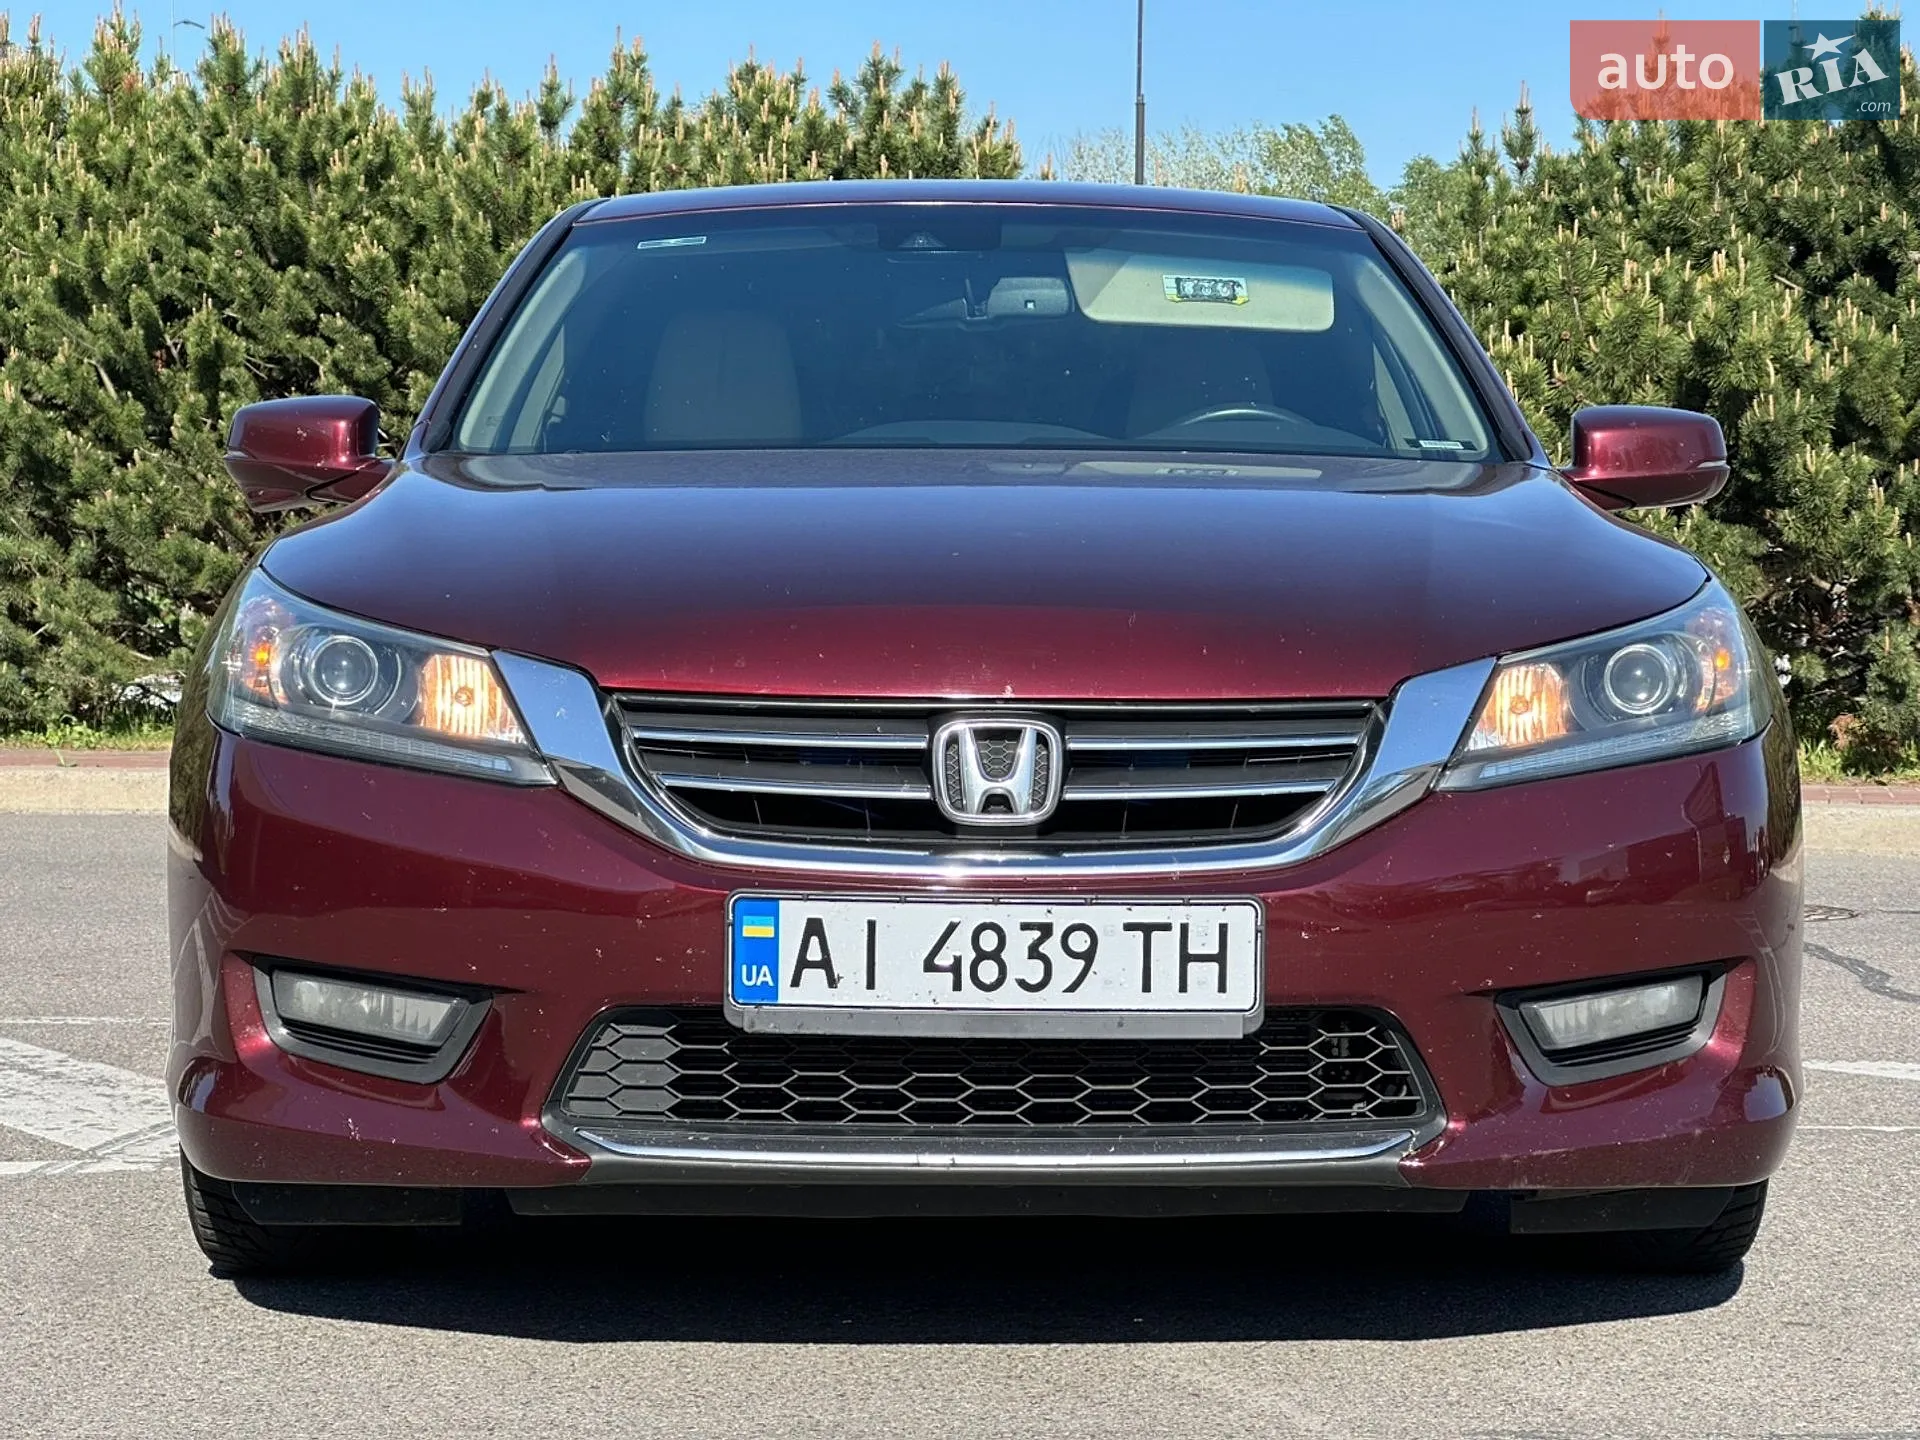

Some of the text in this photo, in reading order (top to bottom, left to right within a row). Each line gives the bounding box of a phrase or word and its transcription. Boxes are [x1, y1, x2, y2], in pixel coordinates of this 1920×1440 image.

[741, 963, 775, 987] UA
[790, 917, 1229, 994] AI 4839 TH
